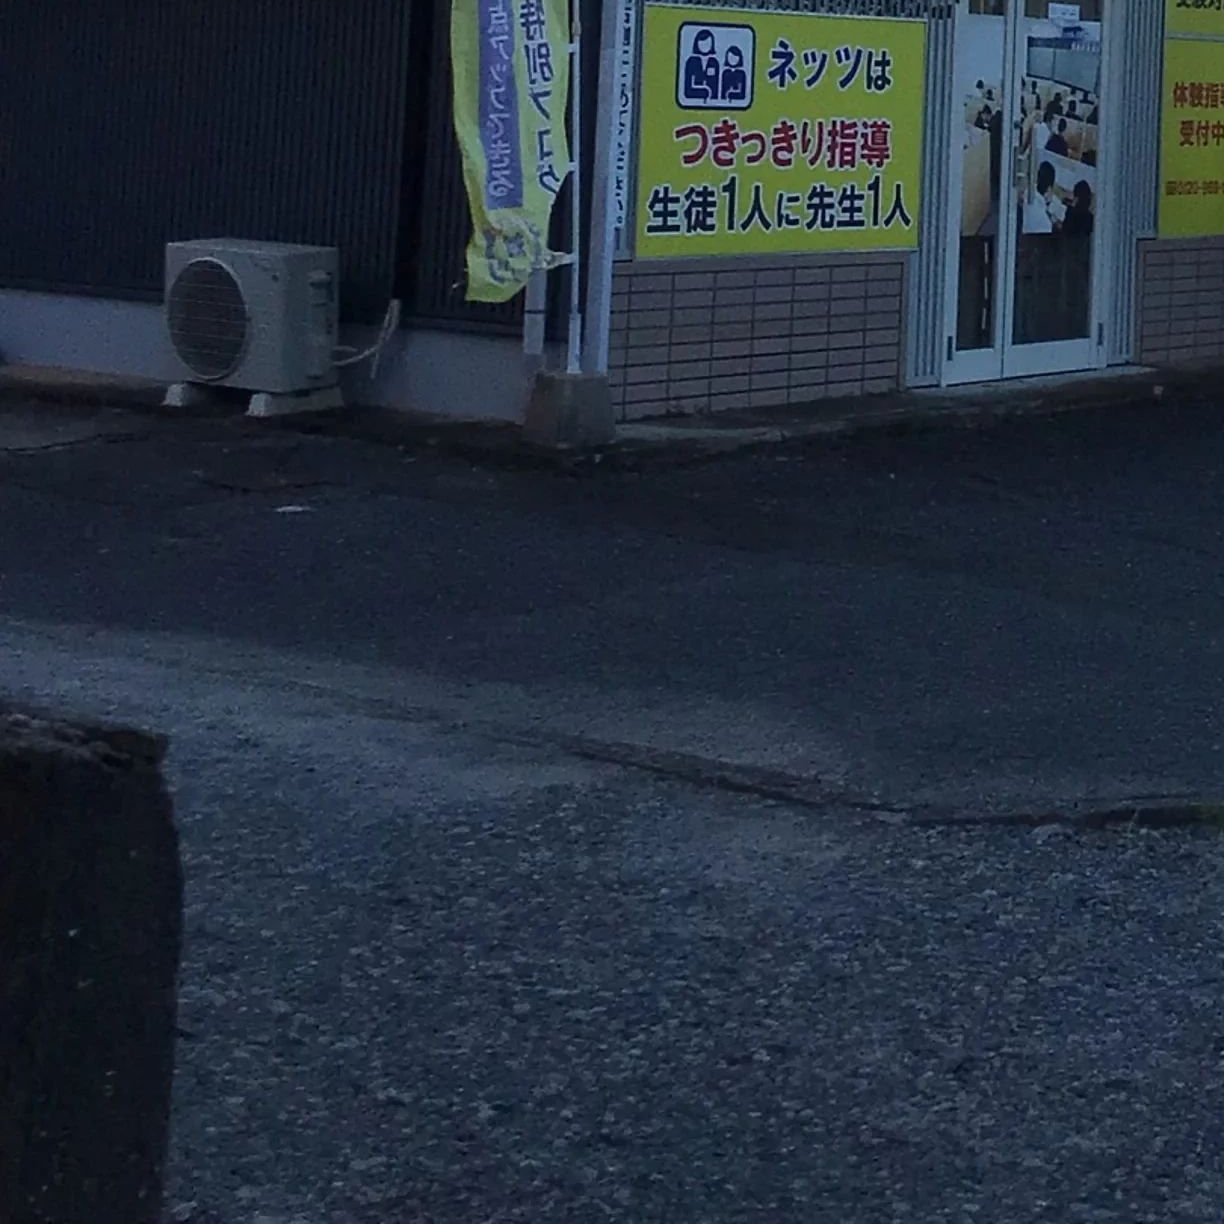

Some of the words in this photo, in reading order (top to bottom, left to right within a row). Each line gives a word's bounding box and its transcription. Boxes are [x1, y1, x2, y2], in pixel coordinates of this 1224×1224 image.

[768, 39, 892, 92] ネッツは
[674, 119, 891, 169] つきっきり指導
[645, 175, 912, 234] 生徒1人に先生1人
